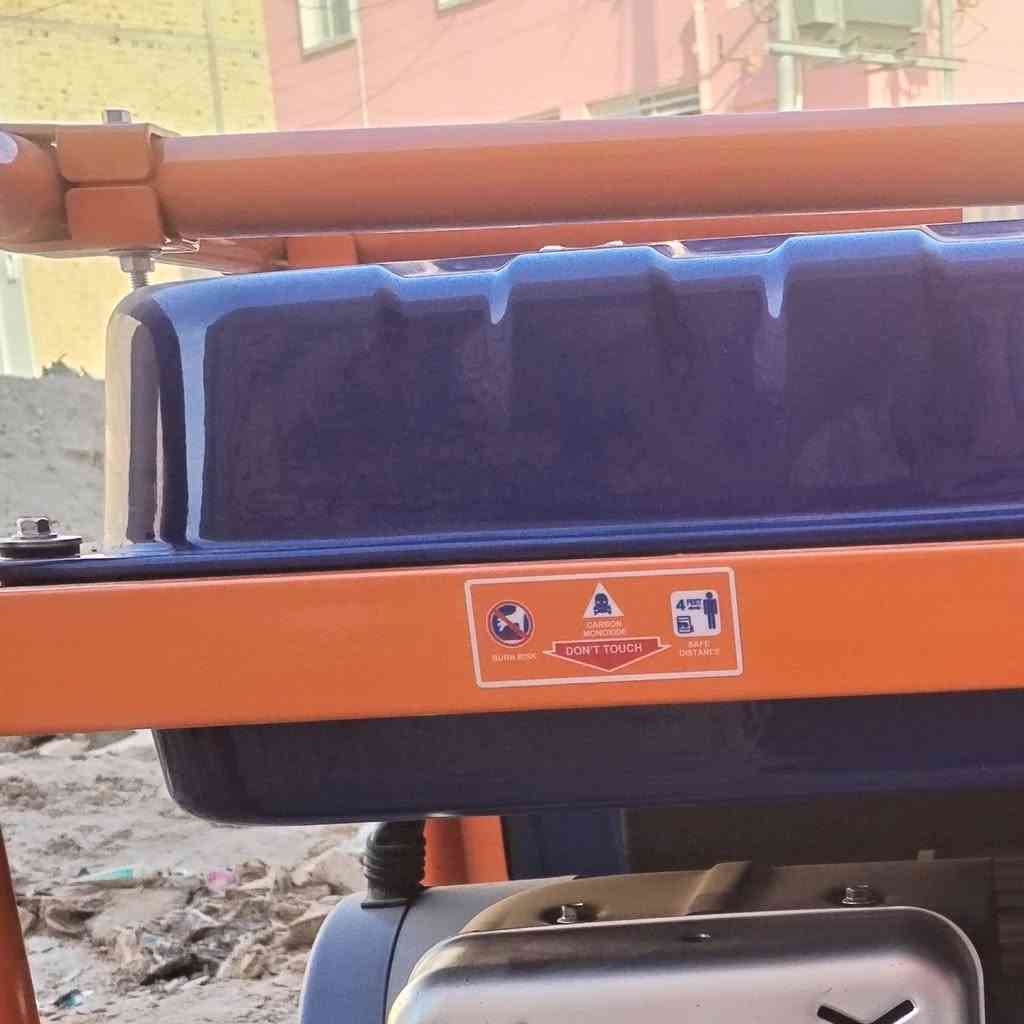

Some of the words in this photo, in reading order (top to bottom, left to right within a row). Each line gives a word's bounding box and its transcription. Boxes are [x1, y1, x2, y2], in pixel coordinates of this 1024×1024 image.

[676, 599, 686, 611] 4
[565, 646, 601, 657] DON'T
[604, 643, 643, 656] TOUCH
